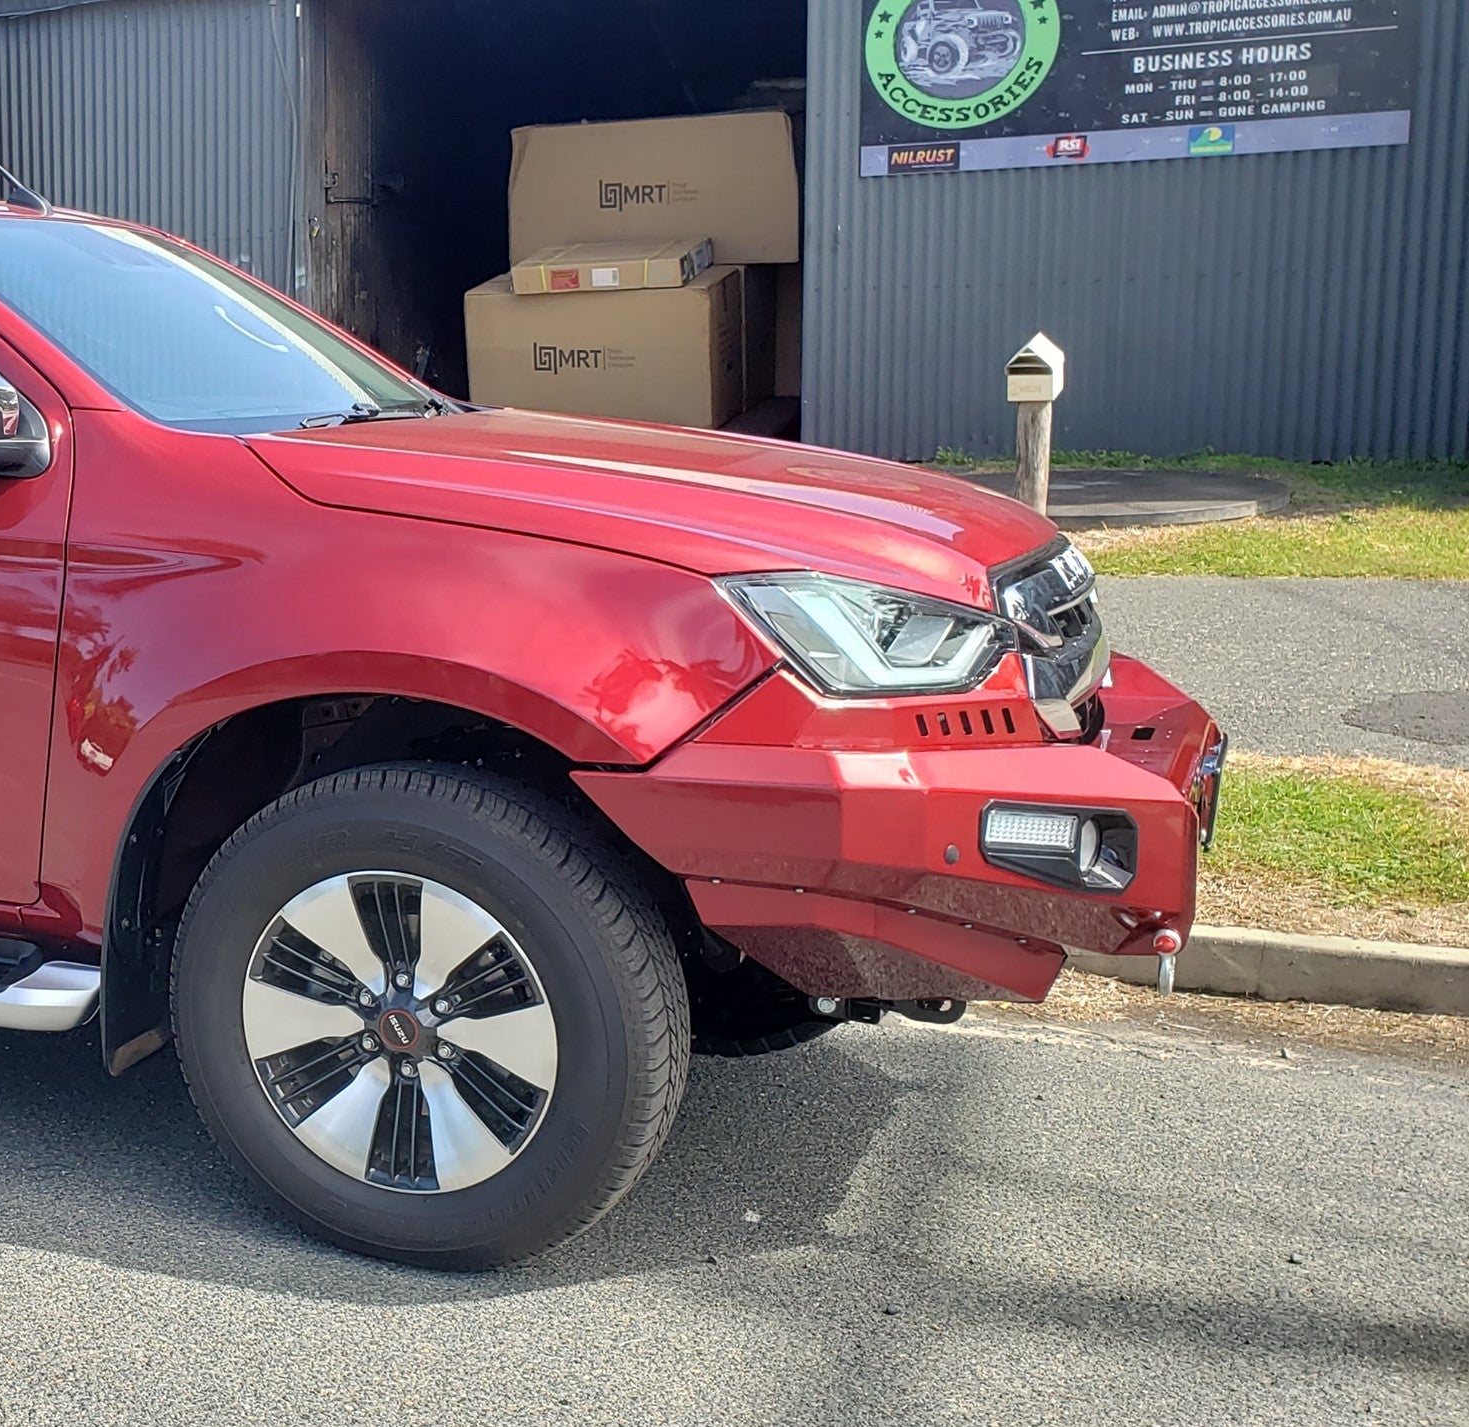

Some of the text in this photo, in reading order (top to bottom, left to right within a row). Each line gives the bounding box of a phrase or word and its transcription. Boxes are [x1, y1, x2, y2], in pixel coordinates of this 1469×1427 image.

[1111, 8, 1351, 41] WEB: WWW.TROPICACCESSORIES.COM.AU
[1112, 7, 1147, 22] EMAIL:
[1133, 42, 1312, 73] BUSINESS HOURS
[878, 56, 1043, 122] ACCESSORIES
[1125, 82, 1153, 94] MON
[1170, 79, 1197, 91] THU
[1219, 74, 1251, 87] 8:00
[1269, 70, 1307, 83] 17:00
[1174, 95, 1196, 106] FRI
[1218, 90, 1251, 102] 8:00
[1269, 85, 1309, 98] 14:00
[1121, 113, 1148, 124] SAT
[1165, 109, 1194, 121] SUN
[1218, 105, 1255, 117] GONE
[1261, 100, 1326, 115] CAMPING
[890, 149, 955, 165] NILRUST
[623, 184, 667, 204] MRT
[559, 349, 602, 368] MRT
[388, 1014, 409, 1045] ISUZU
